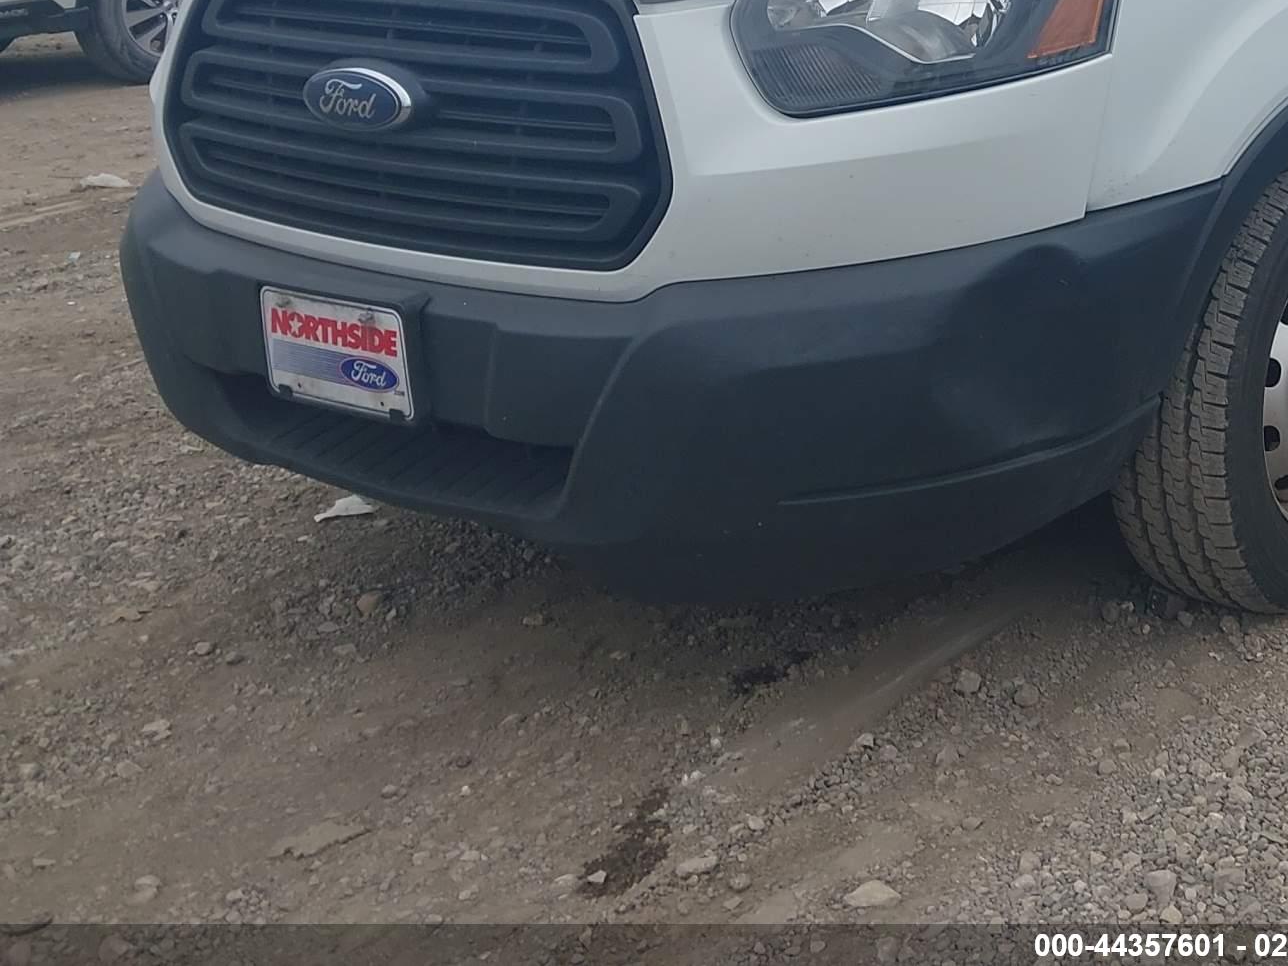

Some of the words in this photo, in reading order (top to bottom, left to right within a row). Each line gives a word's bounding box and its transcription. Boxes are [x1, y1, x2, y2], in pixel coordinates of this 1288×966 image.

[319, 78, 377, 119] Ford
[270, 307, 398, 357] NORTHSIDE
[350, 360, 387, 387] Ford
